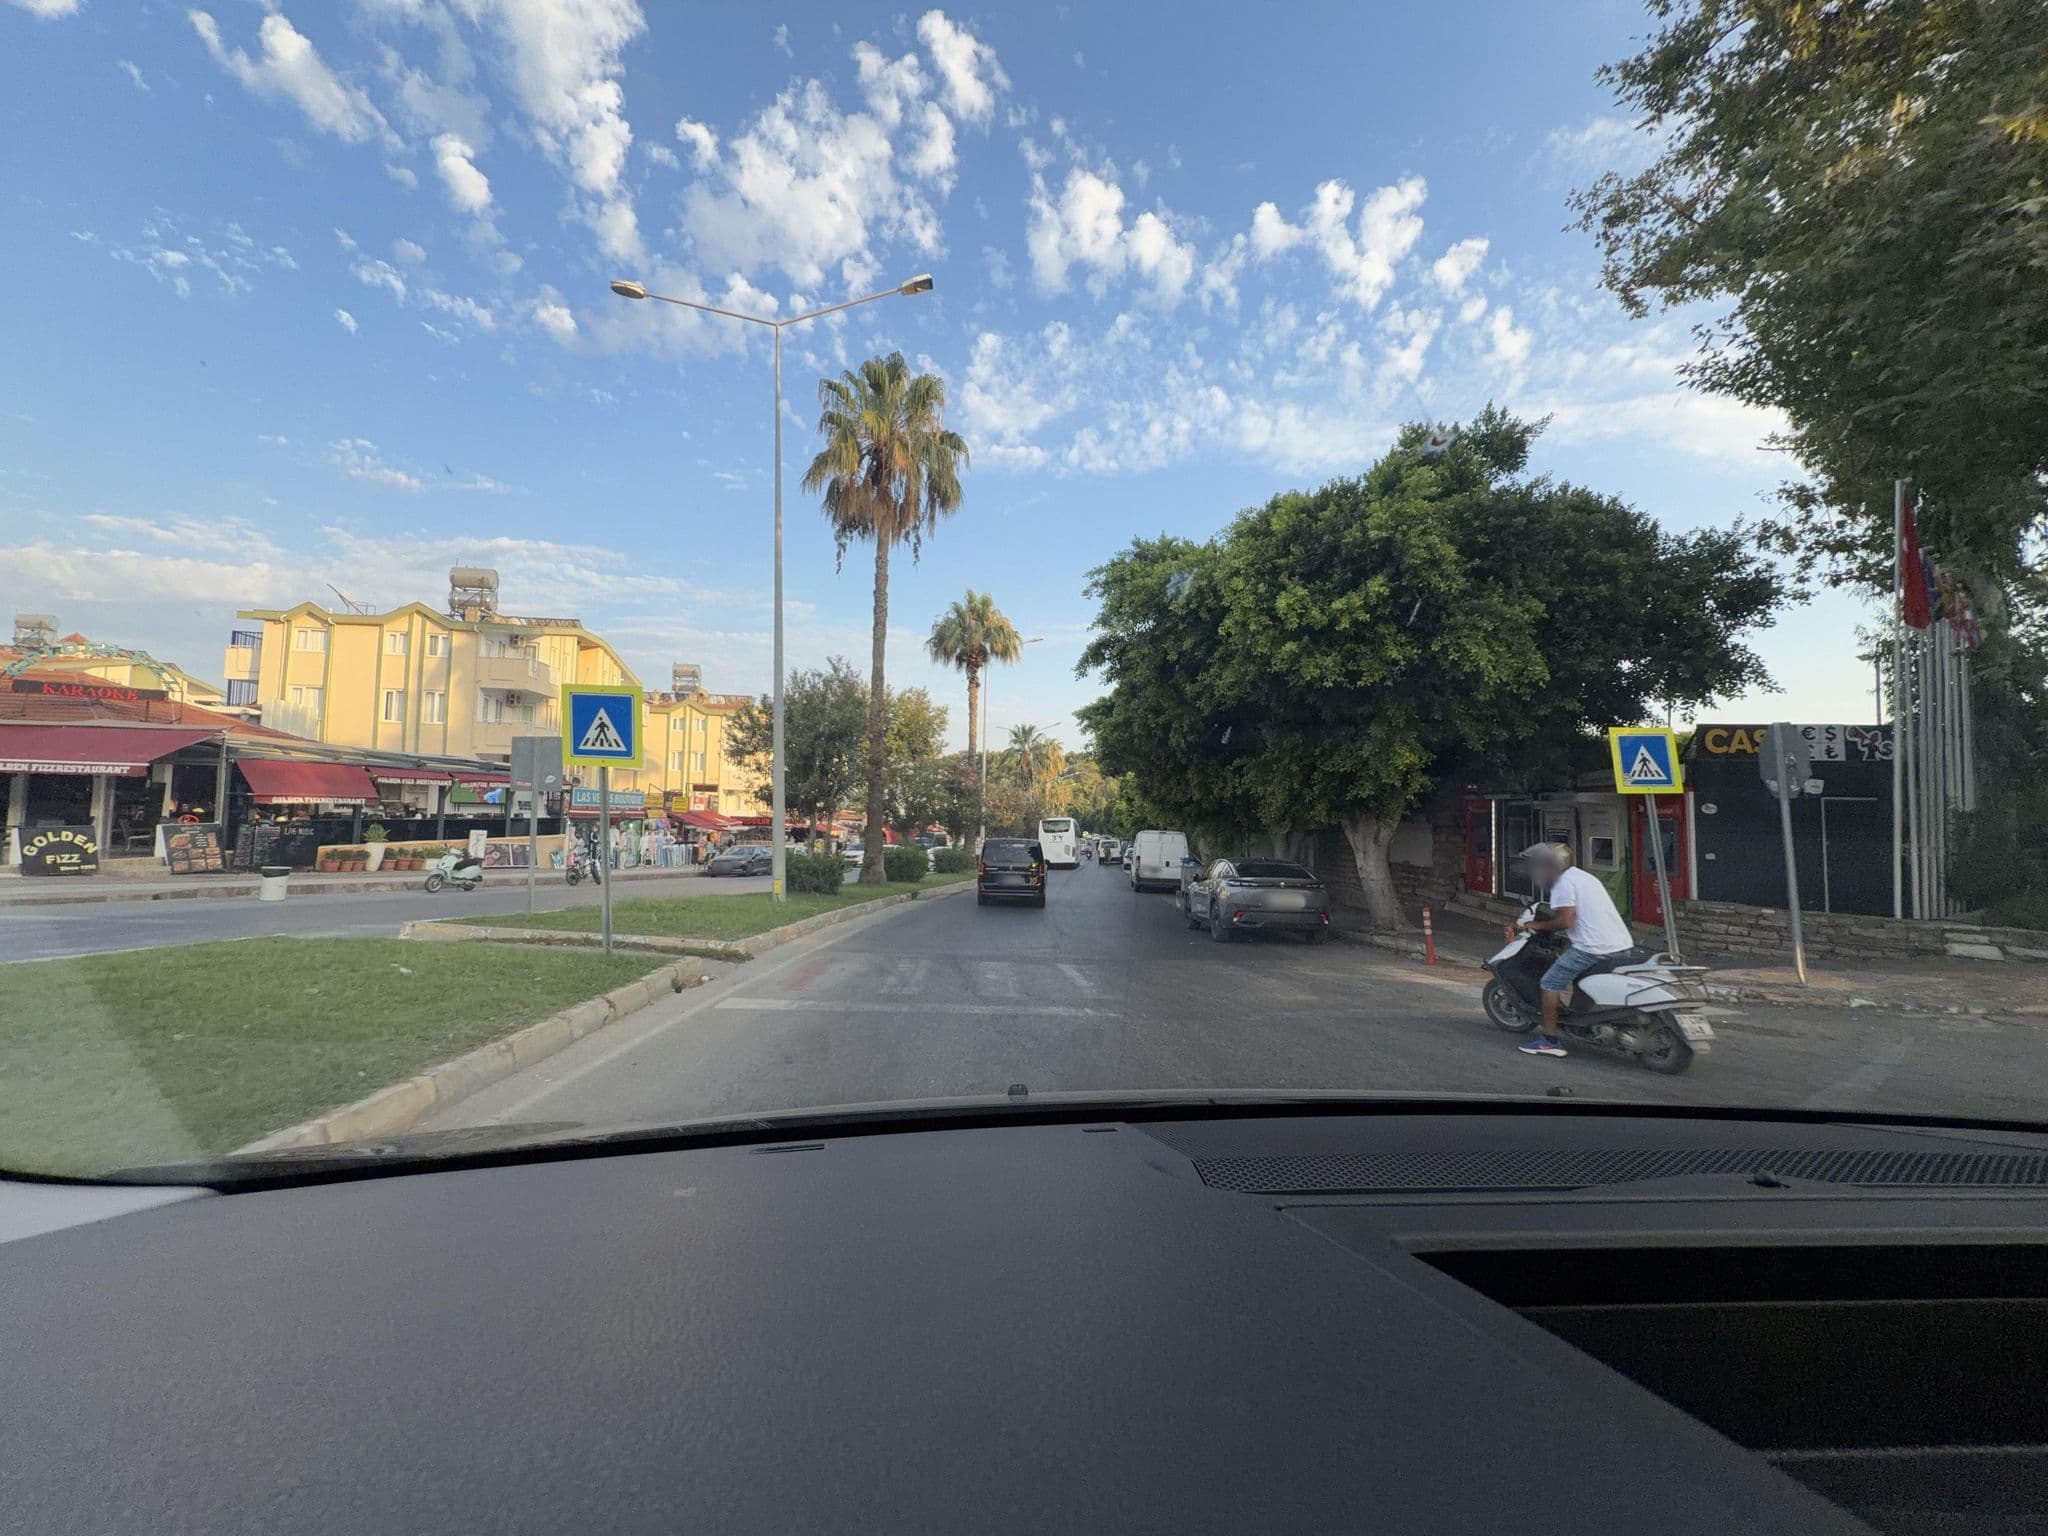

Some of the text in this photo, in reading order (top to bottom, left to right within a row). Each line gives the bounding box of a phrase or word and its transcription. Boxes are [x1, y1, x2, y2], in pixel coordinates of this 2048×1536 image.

[42, 682, 137, 700] KARAOKE
[576, 791, 591, 803] LAS
[592, 793, 614, 804] VES
[22, 829, 98, 856] GOLDEN
[45, 854, 81, 865] FIZZ
